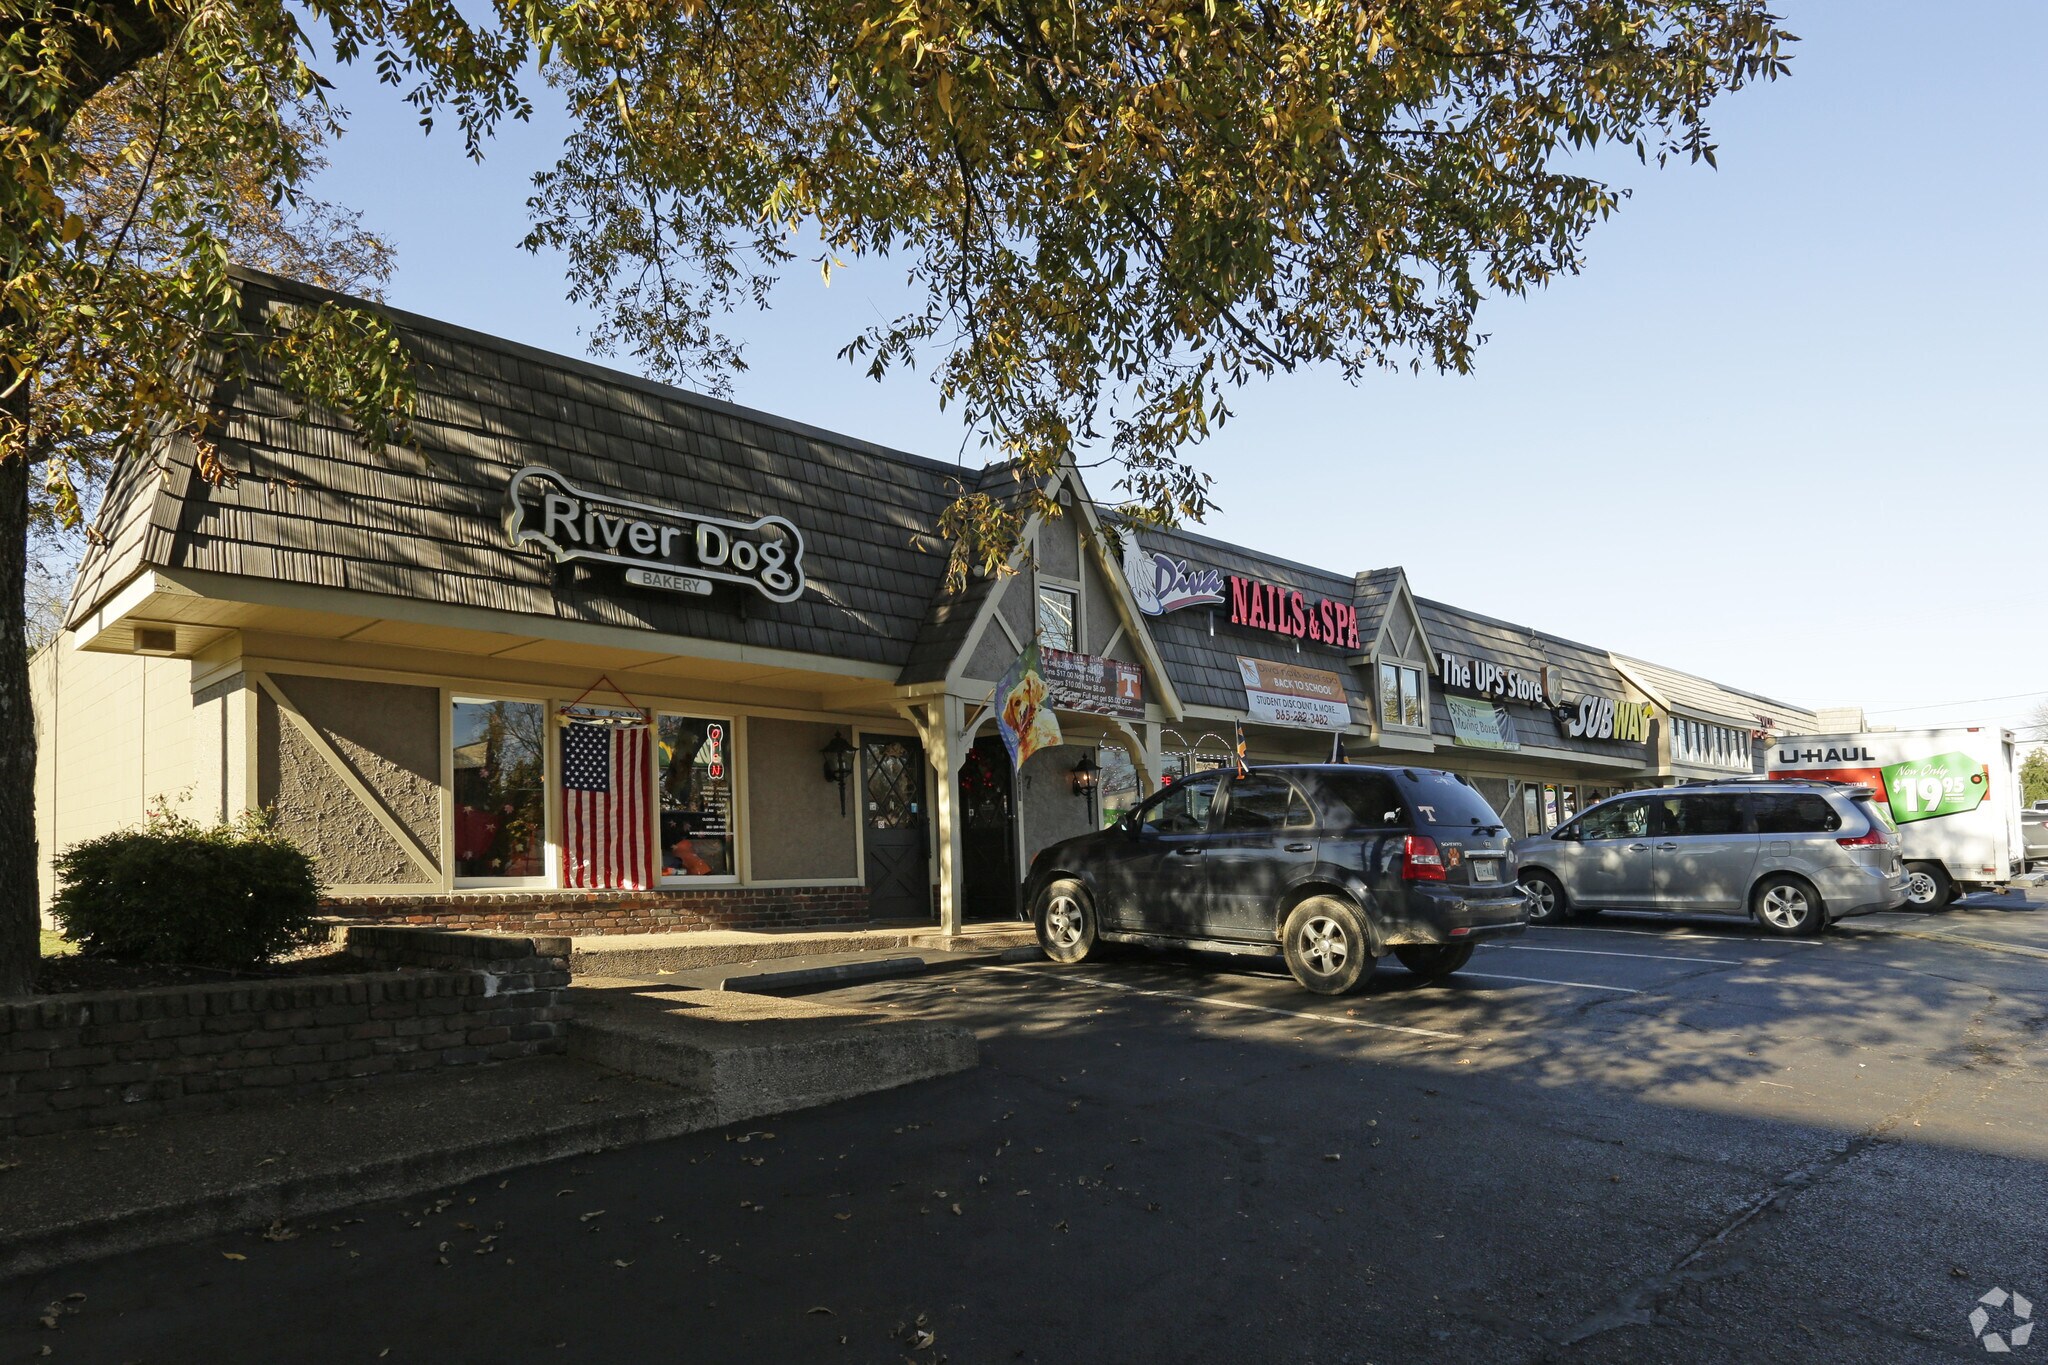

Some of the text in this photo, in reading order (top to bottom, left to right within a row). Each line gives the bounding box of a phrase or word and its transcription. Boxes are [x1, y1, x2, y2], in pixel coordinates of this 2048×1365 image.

[545, 493, 793, 590] River Dog
[642, 571, 700, 593] BAKERY
[1155, 553, 1224, 597] Diva
[1231, 575, 1360, 649] NAILS & SPA
[1257, 664, 1279, 676] Diva
[1441, 653, 1543, 703] The UPS Store
[1121, 672, 1138, 698] T
[1274, 677, 1332, 695] BACK TO SCHOOL
[1256, 695, 1281, 708] STUDENT
[1282, 698, 1312, 711] DISCOUNT
[1480, 721, 1499, 735] Boxes
[1569, 694, 1653, 742] SUBWAY
[1779, 747, 1875, 763] U-HAUL
[1896, 763, 1949, 777] Now Only
[1417, 805, 1436, 822] T
